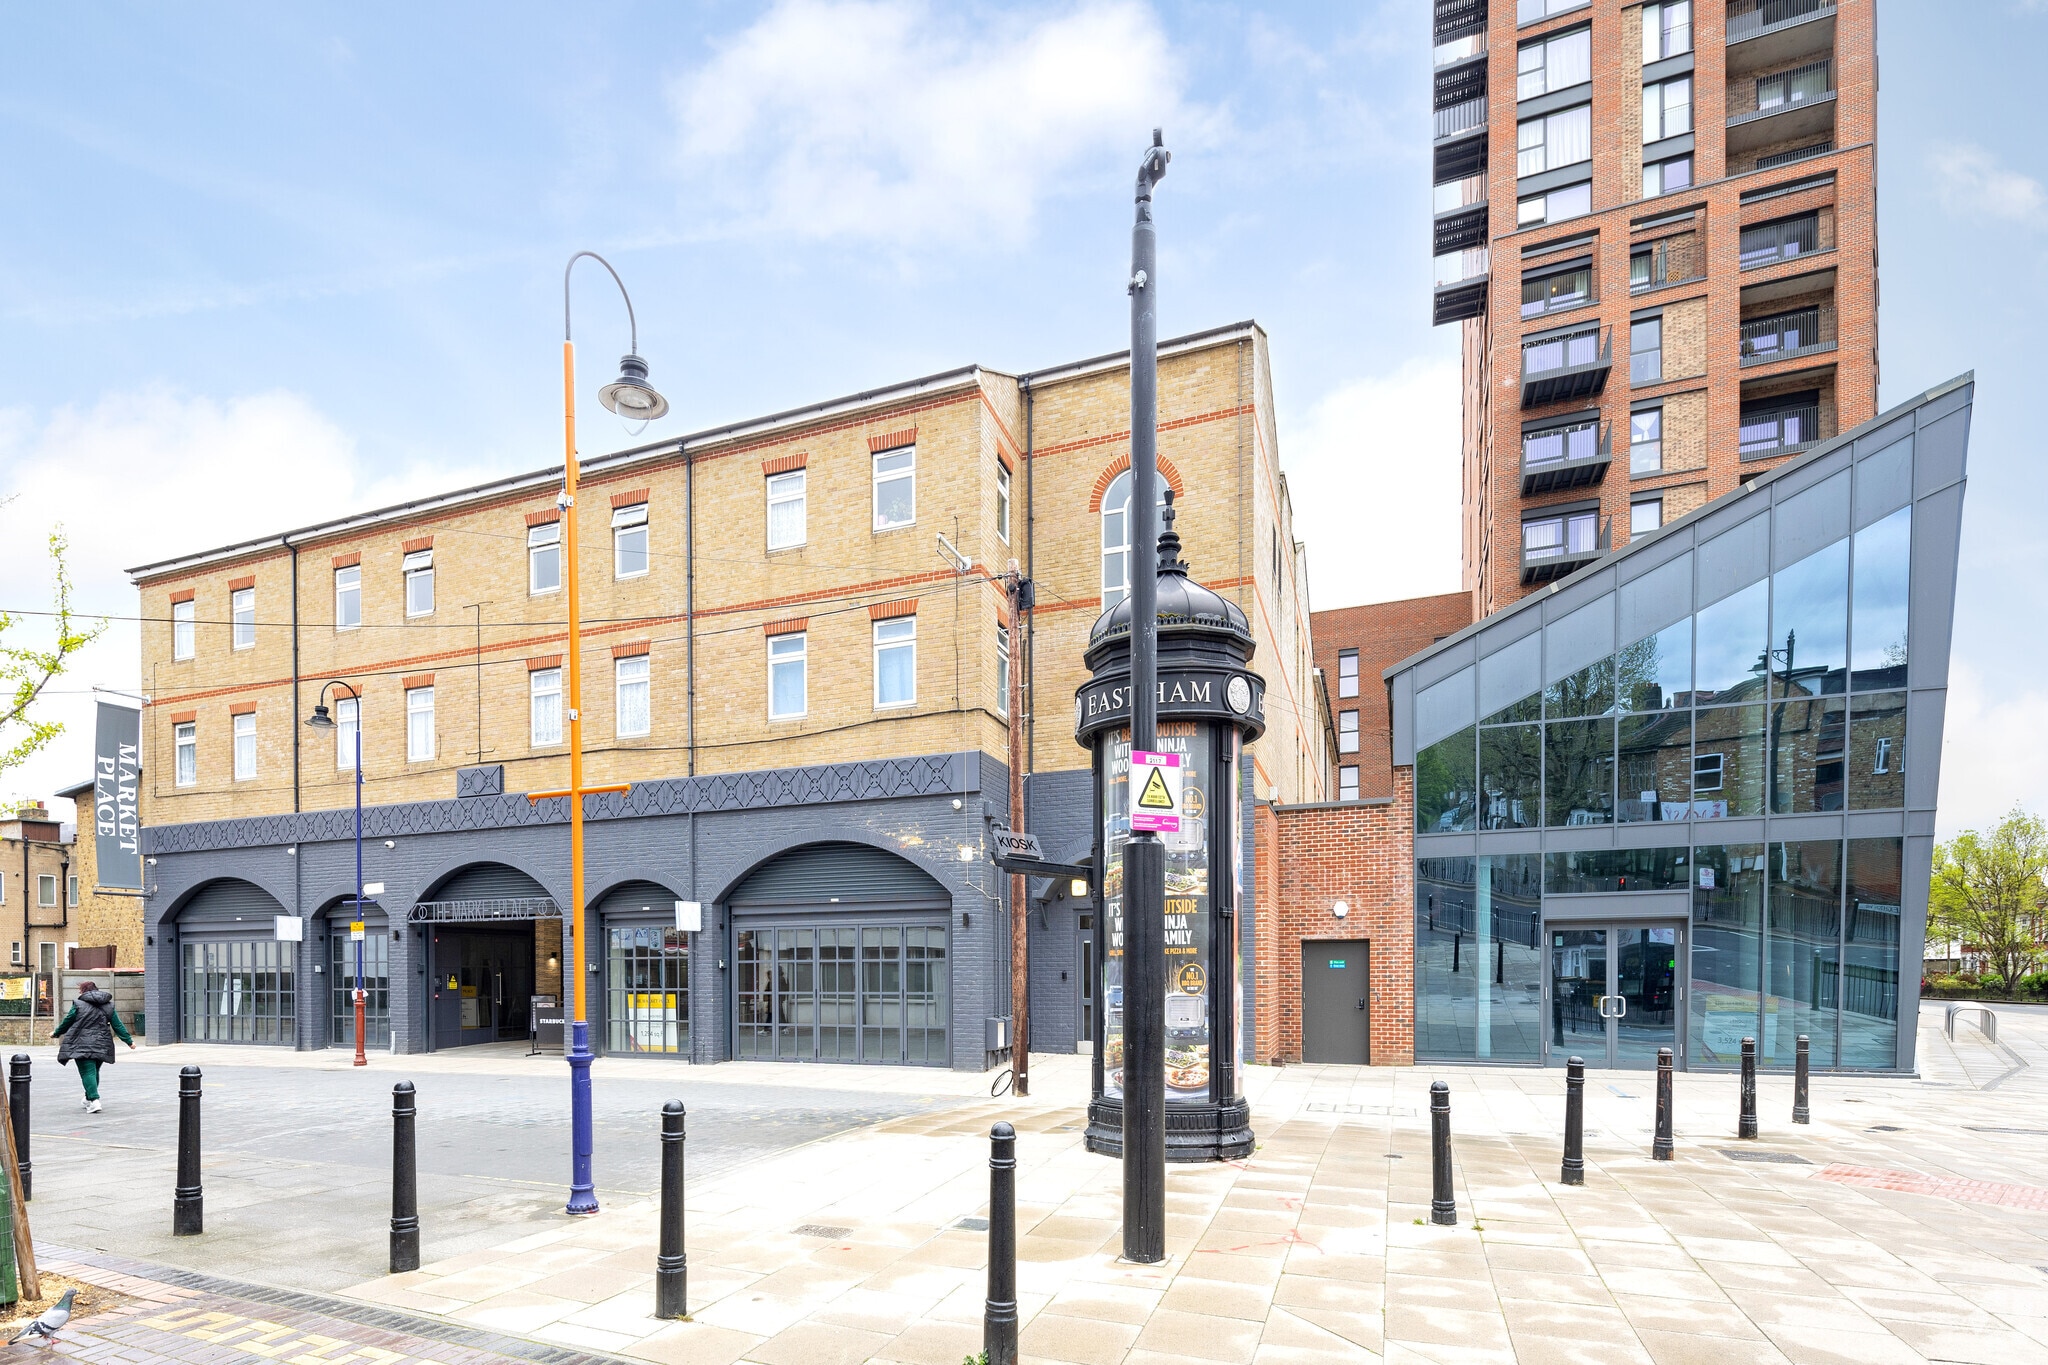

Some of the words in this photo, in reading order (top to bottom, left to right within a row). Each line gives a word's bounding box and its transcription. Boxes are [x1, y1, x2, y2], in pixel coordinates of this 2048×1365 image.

[1108, 729, 1120, 746] IT'S
[1156, 722, 1197, 737] OUTSIDE
[1156, 738, 1187, 753] NINJA
[97, 754, 116, 837] PLACE
[116, 742, 137, 854] MARKET
[997, 836, 1037, 851] KIOSK
[1164, 899, 1197, 914] UTSIDE
[1164, 914, 1188, 930] INJA
[1164, 930, 1192, 945] AMILY
